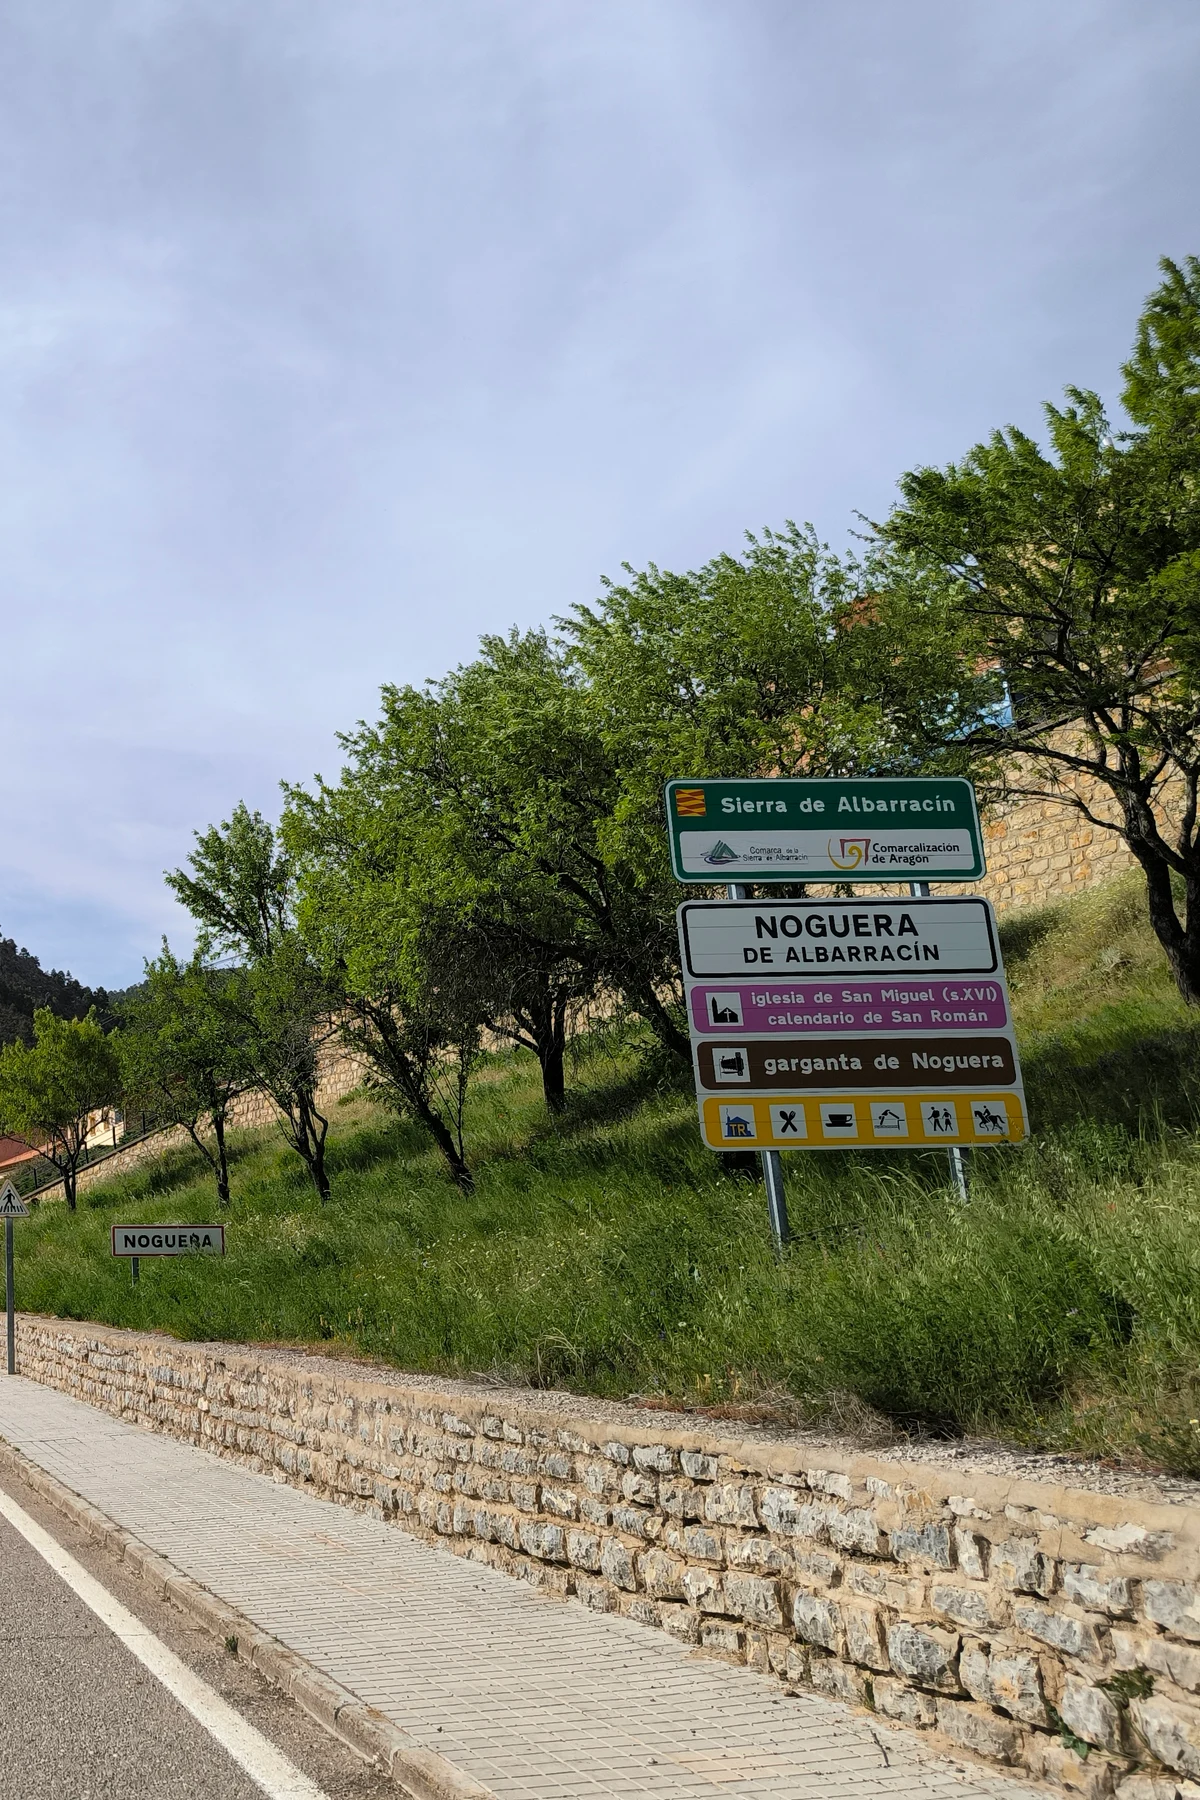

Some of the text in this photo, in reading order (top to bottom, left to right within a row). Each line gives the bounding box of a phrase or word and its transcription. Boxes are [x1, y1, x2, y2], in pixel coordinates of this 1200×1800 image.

[721, 795, 956, 813] Sierra de Albarracín
[750, 846, 781, 854] Comarca
[872, 842, 960, 853] Comarcalización
[872, 853, 929, 866] de Aragón
[755, 913, 919, 939] NOGUERA
[744, 941, 940, 963] DE ALBARRACÍN
[752, 986, 998, 1008] iglesia de San Miguel (s.XVI)
[768, 1008, 988, 1025] calendario de San Román
[764, 1052, 1004, 1074] garganta de Noguera
[729, 1123, 747, 1136] TR
[124, 1234, 211, 1248] NOGUERA
